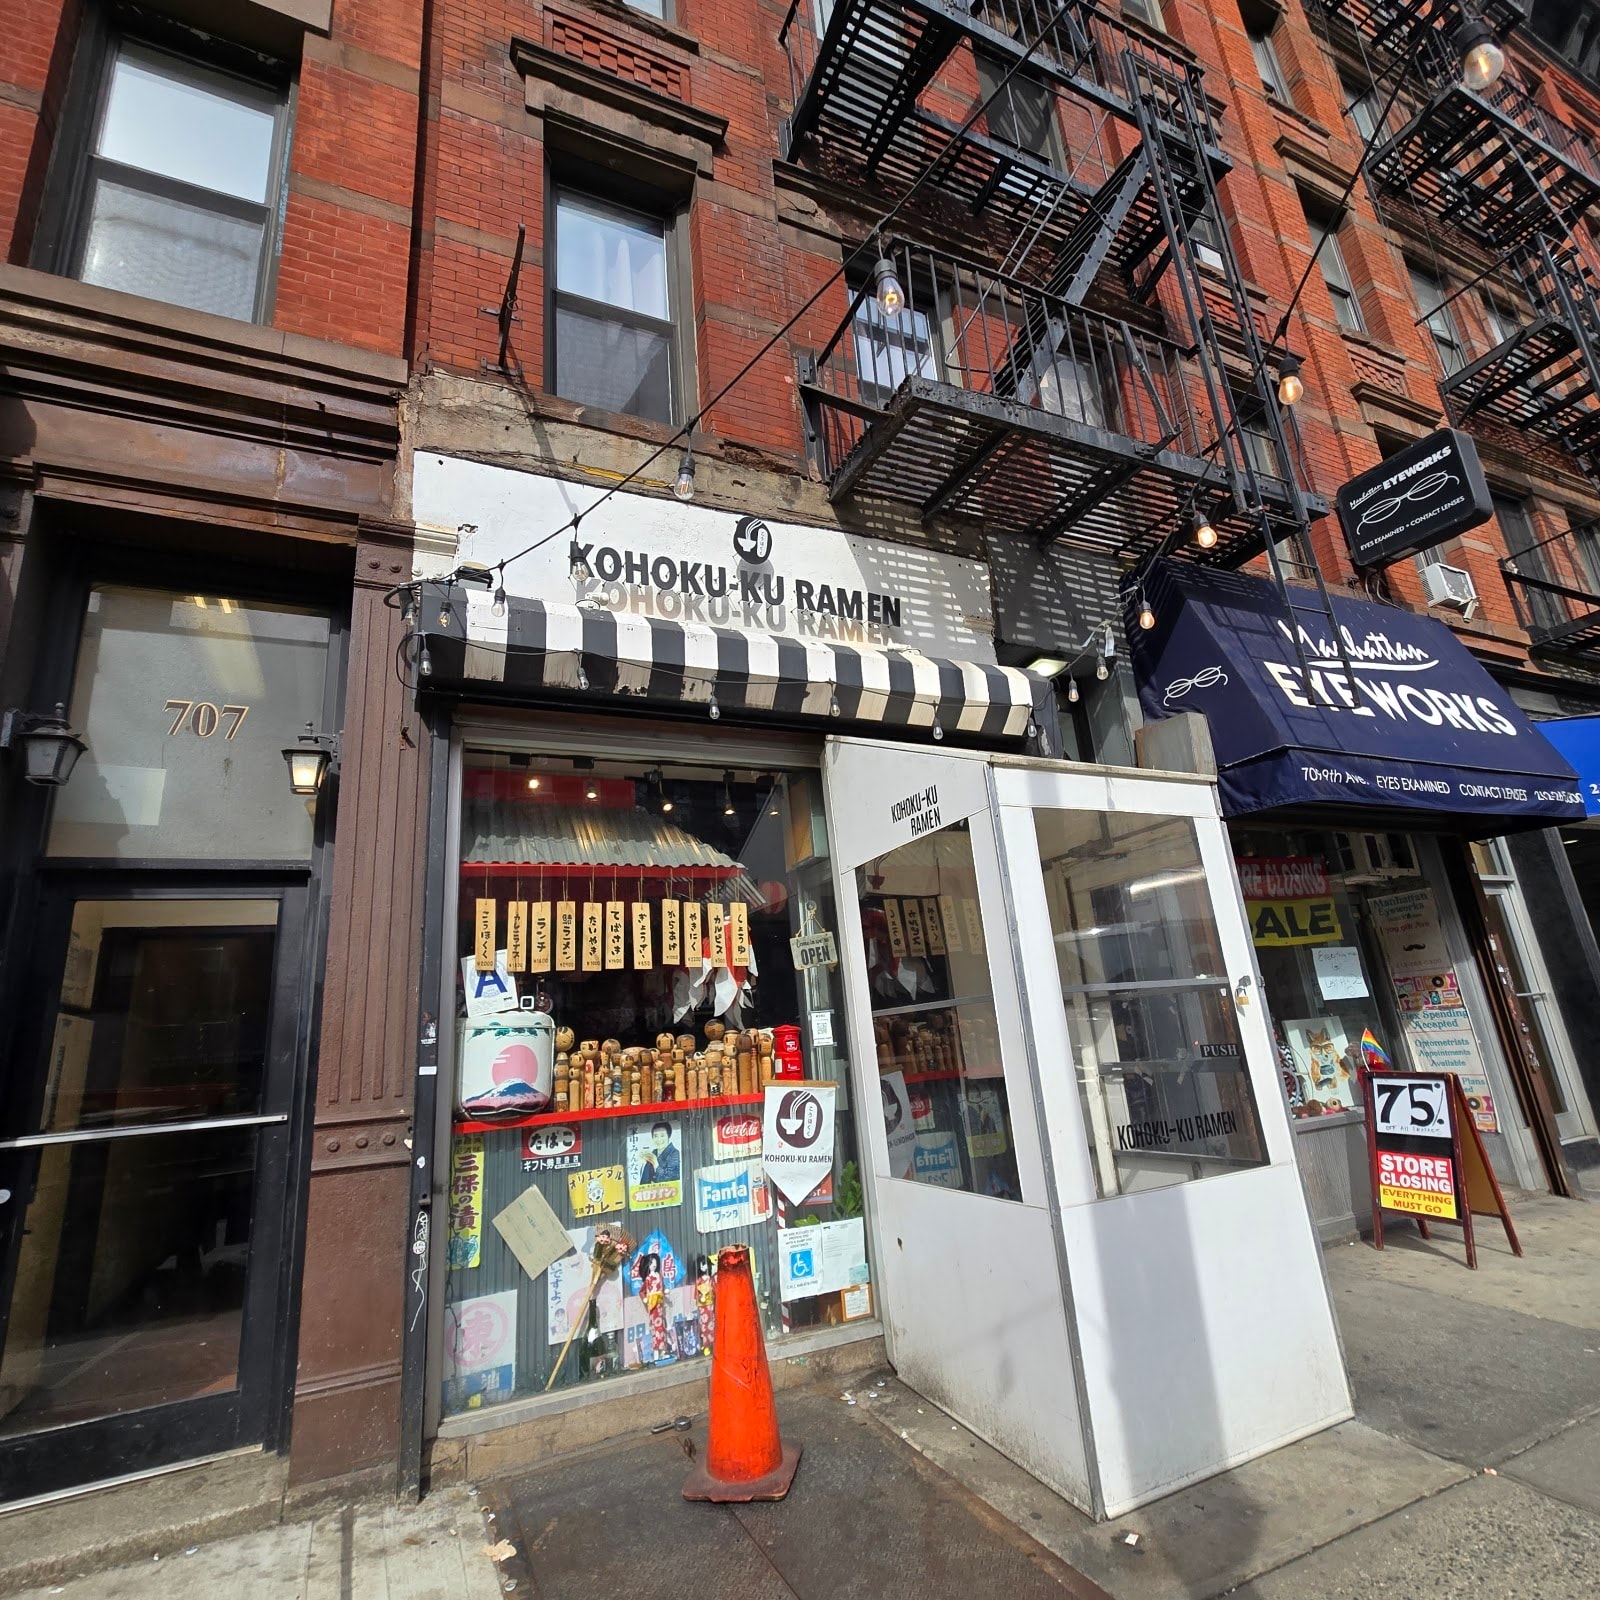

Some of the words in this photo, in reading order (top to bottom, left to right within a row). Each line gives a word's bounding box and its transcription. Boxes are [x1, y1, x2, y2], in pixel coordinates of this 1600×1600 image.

[1383, 446, 1452, 490] EYEWORKS
[1360, 540, 1375, 551] EYES
[1375, 525, 1405, 544] EXAMINED
[1410, 508, 1440, 527] CONTACT
[1441, 496, 1465, 511] LENSES
[569, 541, 785, 606] KOHOKU-KU
[795, 579, 901, 627] RAMEN
[1263, 661, 1517, 736] EYEWORKS
[162, 699, 250, 740] 707
[1345, 771, 1370, 786] Ave.
[1376, 775, 1400, 790] EYES
[1401, 777, 1450, 794] EXAMINED
[1459, 783, 1501, 799] CONTACT
[1501, 787, 1528, 801] LENSES
[890, 784, 938, 824] KOHOKU-KU
[910, 806, 942, 837] RAMEN
[1264, 862, 1328, 897] CLOSING
[1375, 892, 1428, 908] Manhattan
[1378, 902, 1425, 917] Eyeworks
[480, 910, 492, 959] こうほくく
[535, 917, 547, 952] ランチ
[610, 910, 622, 956] てばさき
[667, 910, 678, 951] からあげ
[688, 912, 698, 952] やきにく
[713, 914, 723, 955] カルピス
[737, 913, 746, 955] しょうゆ
[1250, 903, 1336, 938] ALE
[588, 915, 598, 956] たいやき
[801, 945, 831, 965] OPEN
[474, 970, 508, 998] A
[1413, 1019, 1459, 1029] Accepted
[1422, 1008, 1469, 1019] Spending
[1203, 1044, 1238, 1057] PUSH
[1414, 1038, 1470, 1049] Optometrists
[1418, 1049, 1471, 1058] Appointments
[1430, 1059, 1467, 1067] Available
[1462, 1077, 1486, 1086] Plans
[1376, 1083, 1445, 1127] 75%
[530, 1130, 573, 1151] たばこ
[1116, 1117, 1195, 1150] KOHOKU-KU
[1195, 1110, 1238, 1139] RAMEN
[523, 1154, 579, 1172] ギフト券
[764, 1154, 807, 1163] KOHOKU-KU
[808, 1155, 832, 1163] RAMEN
[1380, 1154, 1449, 1178] STORE
[569, 1168, 623, 1190] オリエンタル
[1380, 1171, 1452, 1194] CLOSING
[702, 1181, 748, 1208] Fanta
[1383, 1188, 1452, 1205] EVERYTHING
[1393, 1199, 1422, 1211] MUST
[1424, 1205, 1442, 1214] GO
[713, 1209, 739, 1222] ファンタ
